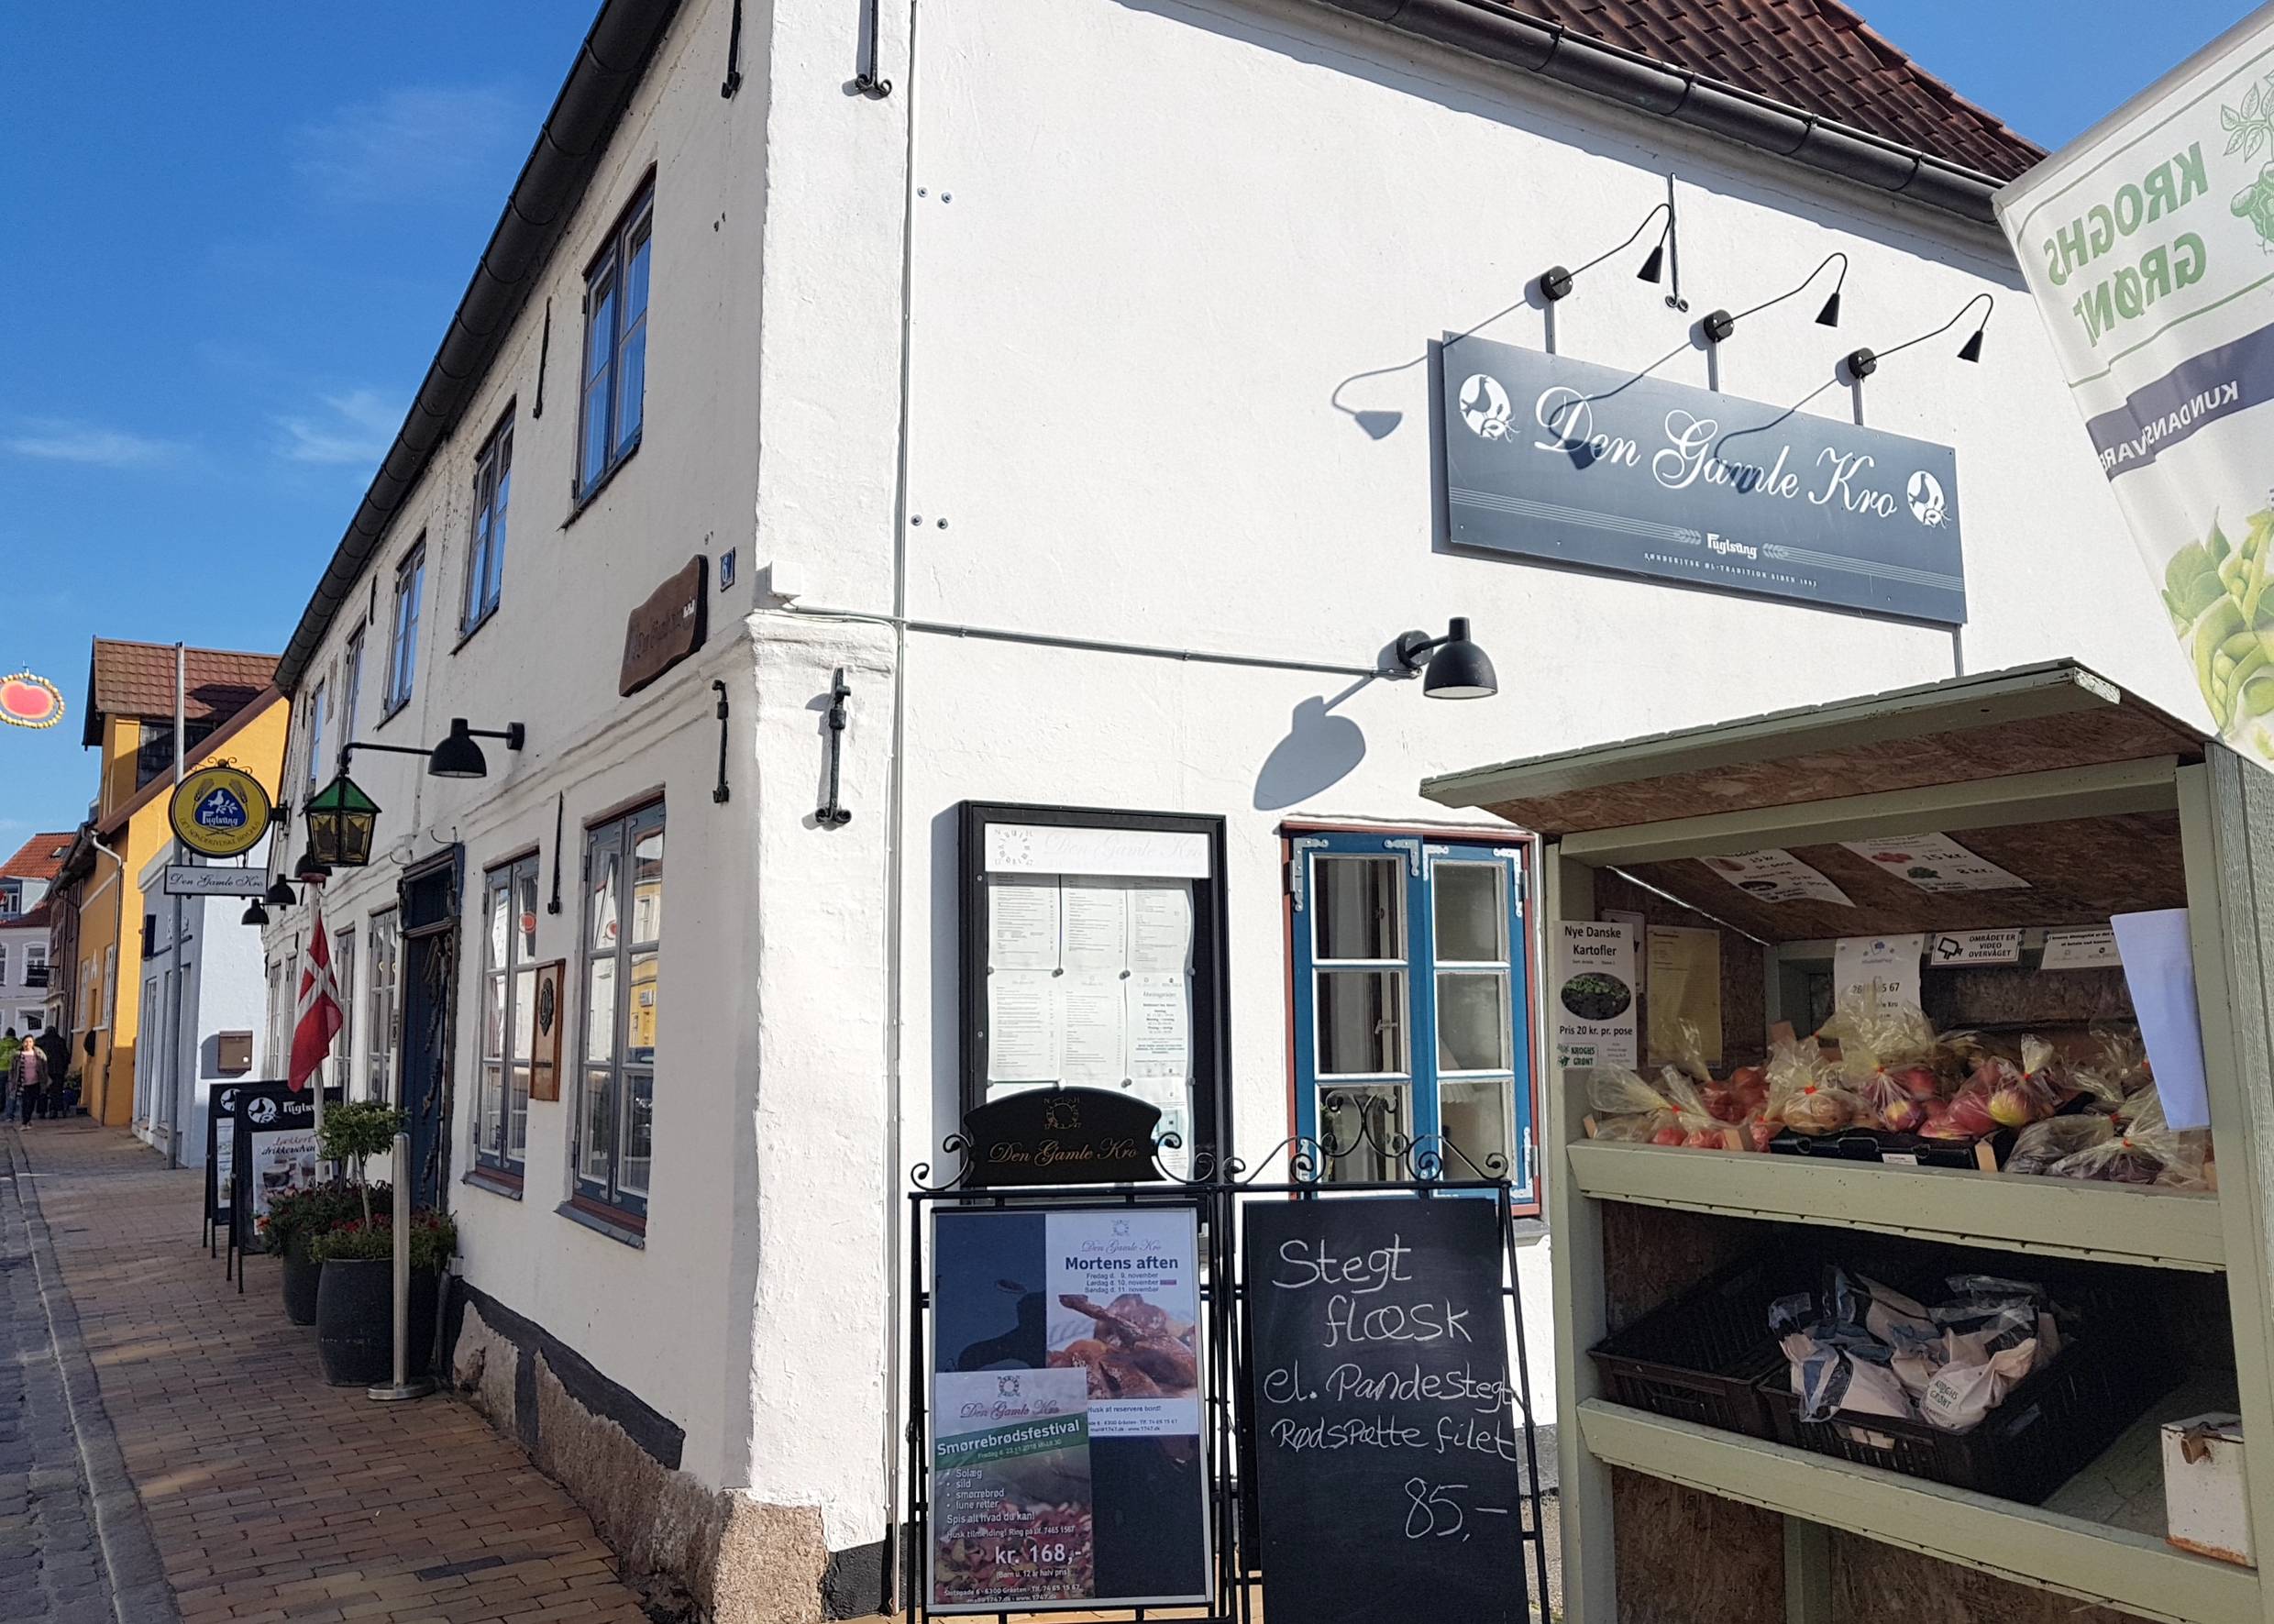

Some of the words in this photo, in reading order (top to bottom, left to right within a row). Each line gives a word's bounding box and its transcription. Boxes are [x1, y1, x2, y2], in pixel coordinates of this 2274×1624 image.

[1534, 386, 1640, 467] Den
[1652, 409, 1799, 499] Gamle
[1808, 447, 1897, 518] Kro
[1706, 533, 1757, 560] Fuglsang
[169, 873, 193, 886] Den
[196, 874, 234, 888] Gamle
[1564, 925, 1584, 939] Nye
[1586, 926, 1621, 938] Danske
[1573, 944, 1617, 956] Kartofler
[1560, 1025, 1574, 1034] Pris
[1577, 1026, 1587, 1034] 20
[1589, 1024, 1598, 1034] kr.
[1601, 1027, 1611, 1036] pr.
[1614, 1027, 1633, 1036] pose
[988, 1142, 1031, 1164] Den
[1033, 1139, 1093, 1166] Gamle
[1097, 1137, 1138, 1161] Kro
[1065, 1256, 1131, 1270] Mortens
[1136, 1255, 1178, 1269] aften
[1273, 1233, 1412, 1294] Stegt
[960, 1402, 988, 1419] Den
[990, 1399, 1030, 1420] Gamle
[937, 1420, 1080, 1456] Smørrebrødsfestival
[955, 1468, 983, 1479] Solæg
[955, 1479, 972, 1488] sild
[955, 1488, 1005, 1498] smørrebrød
[955, 1500, 974, 1509] lune
[977, 1500, 999, 1508] retter
[946, 1514, 966, 1525] Spis
[967, 1513, 978, 1523] alt
[979, 1512, 1001, 1522] hvad
[1003, 1511, 1015, 1521] du
[995, 1545, 1020, 1564] kr.
[1029, 1542, 1082, 1565] 168,-
